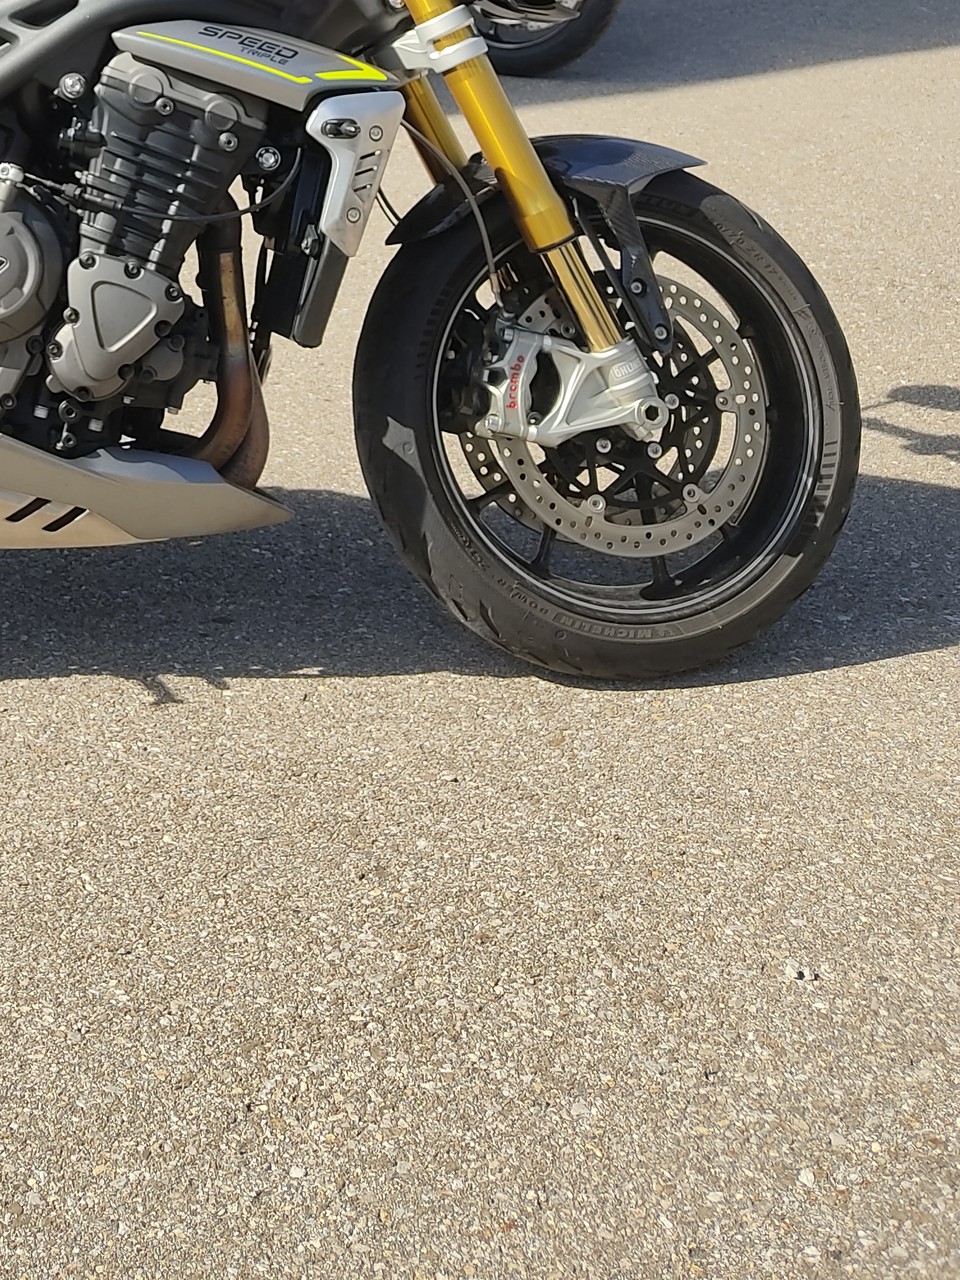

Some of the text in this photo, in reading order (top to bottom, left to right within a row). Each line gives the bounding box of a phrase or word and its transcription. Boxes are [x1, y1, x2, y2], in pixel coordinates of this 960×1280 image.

[198, 26, 299, 59] SPEED
[240, 46, 289, 65] TRIPLE
[506, 355, 525, 410] brembo
[560, 615, 653, 639] MICHELIN
